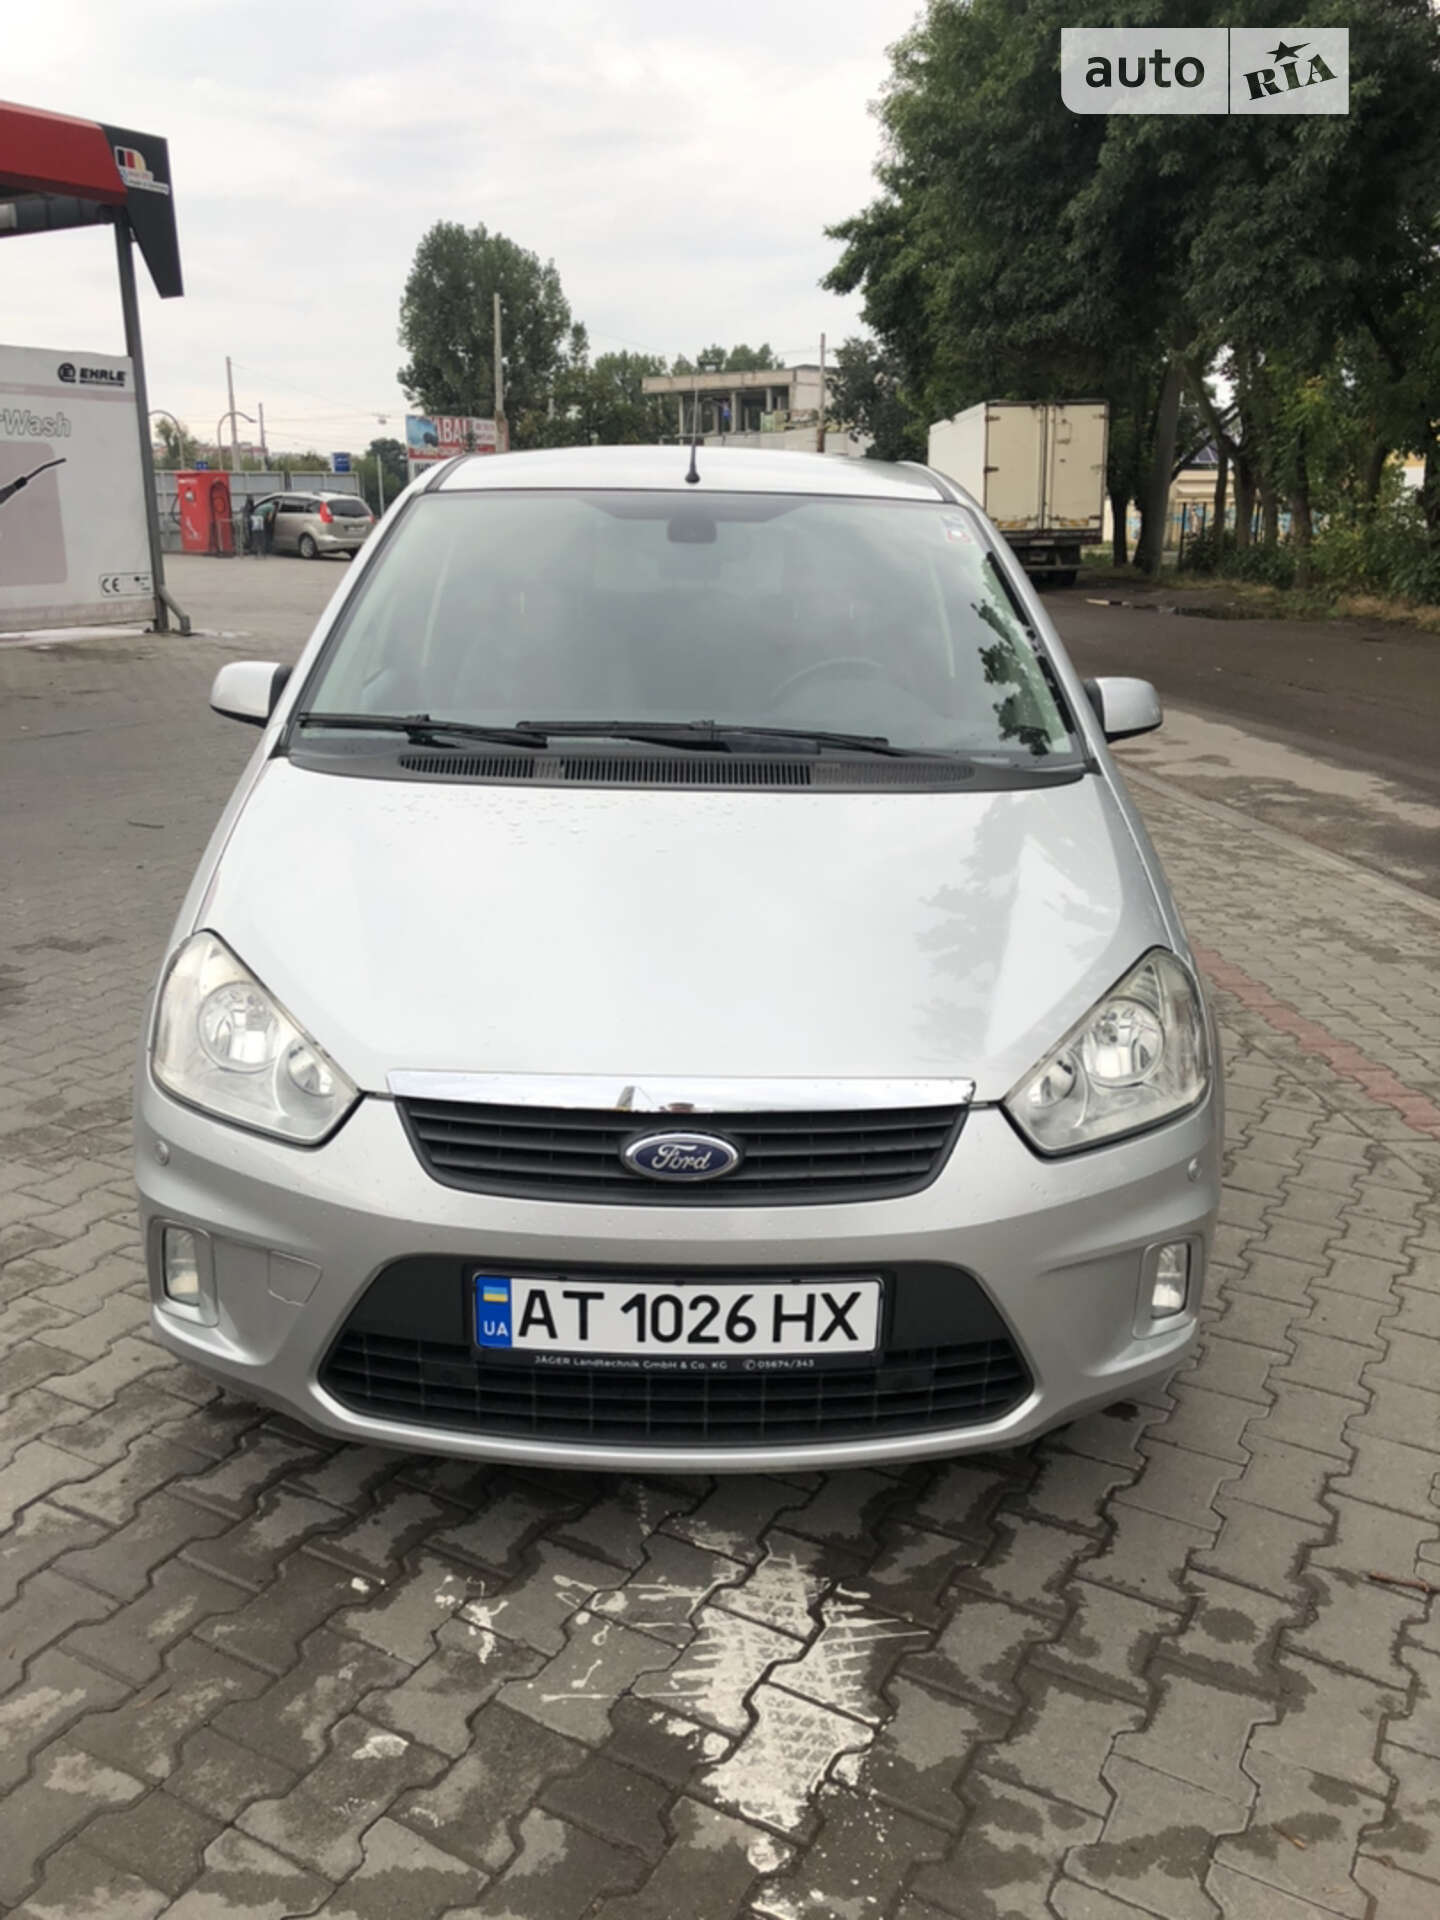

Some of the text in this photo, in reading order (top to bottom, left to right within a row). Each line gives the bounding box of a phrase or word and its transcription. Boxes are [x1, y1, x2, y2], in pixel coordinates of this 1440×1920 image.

[79, 367, 126, 381] EHRLE
[0, 408, 72, 438] Wash
[651, 1143, 713, 1170] Ford
[518, 1289, 861, 1344] AT 1026 HX
[483, 1319, 509, 1337] UA
[642, 1359, 678, 1370] GmbH
[711, 1360, 728, 1370] KG
